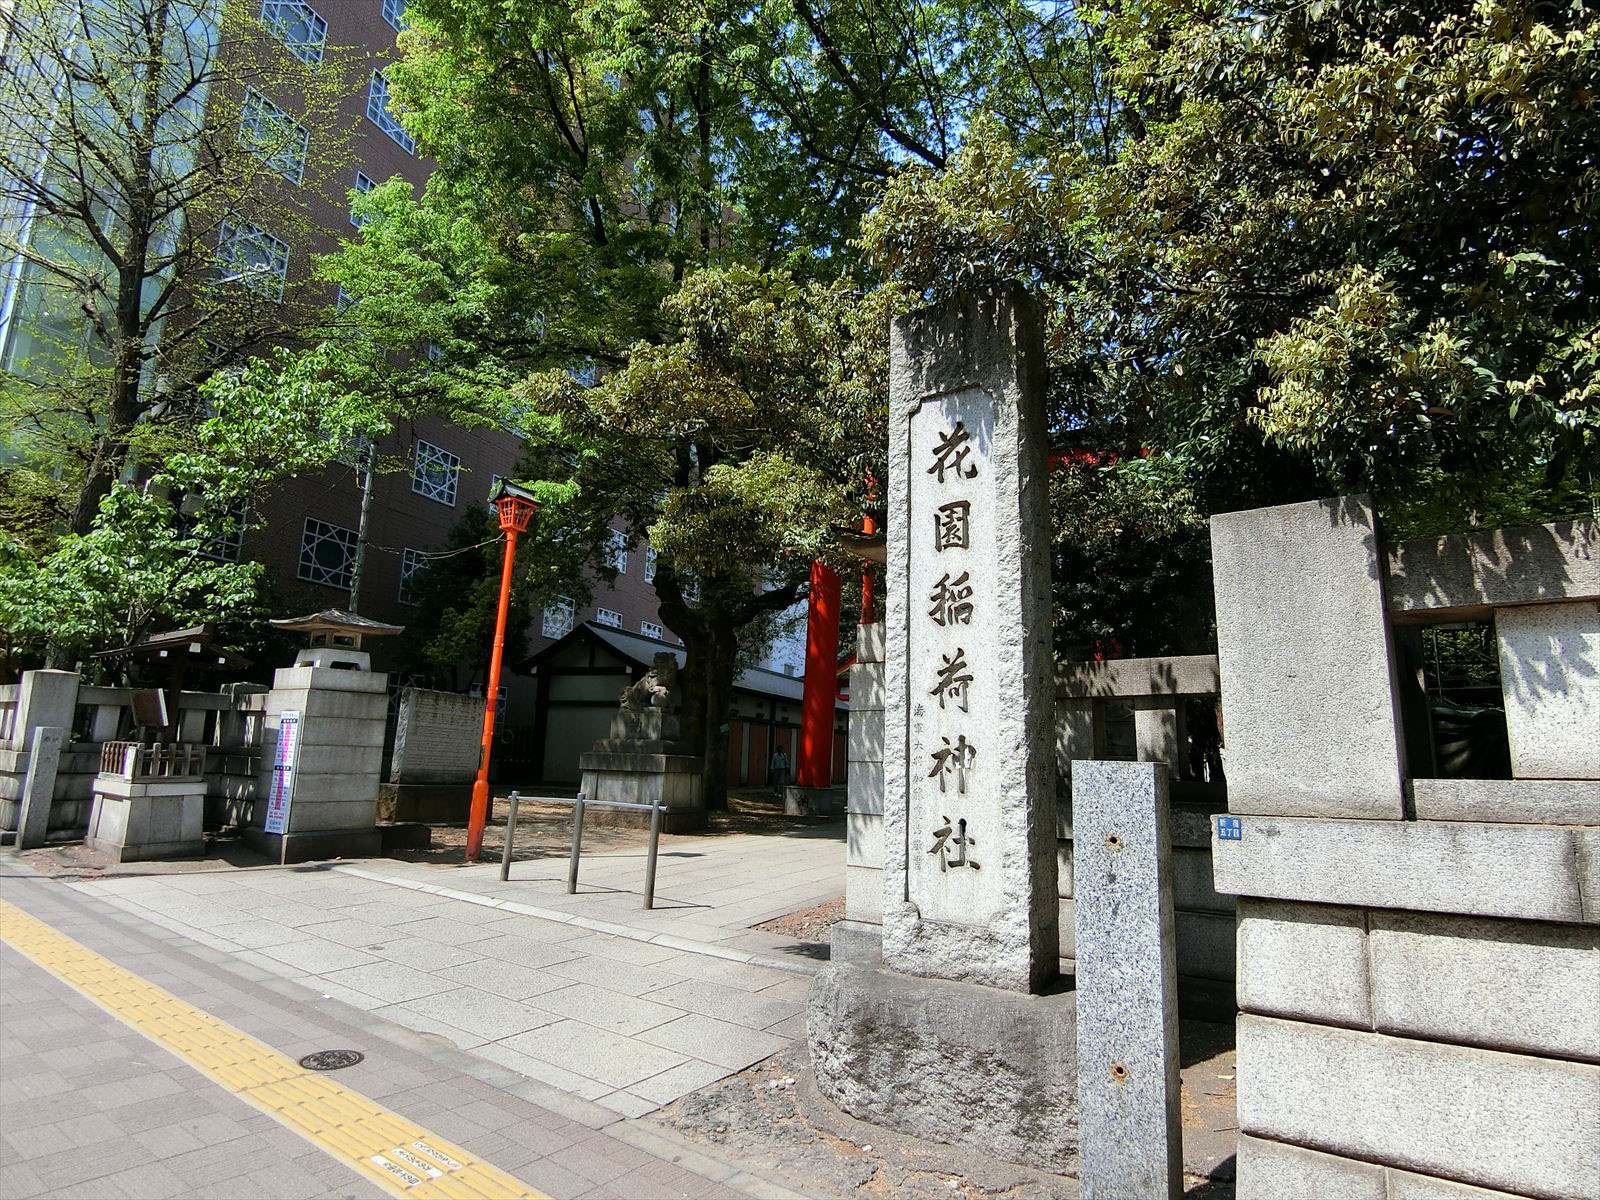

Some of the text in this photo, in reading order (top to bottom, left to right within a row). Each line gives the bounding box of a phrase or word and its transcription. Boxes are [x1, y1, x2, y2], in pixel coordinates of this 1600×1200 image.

[926, 421, 981, 873] 花園稲荷神社
[1220, 828, 1240, 838] 五丁目
